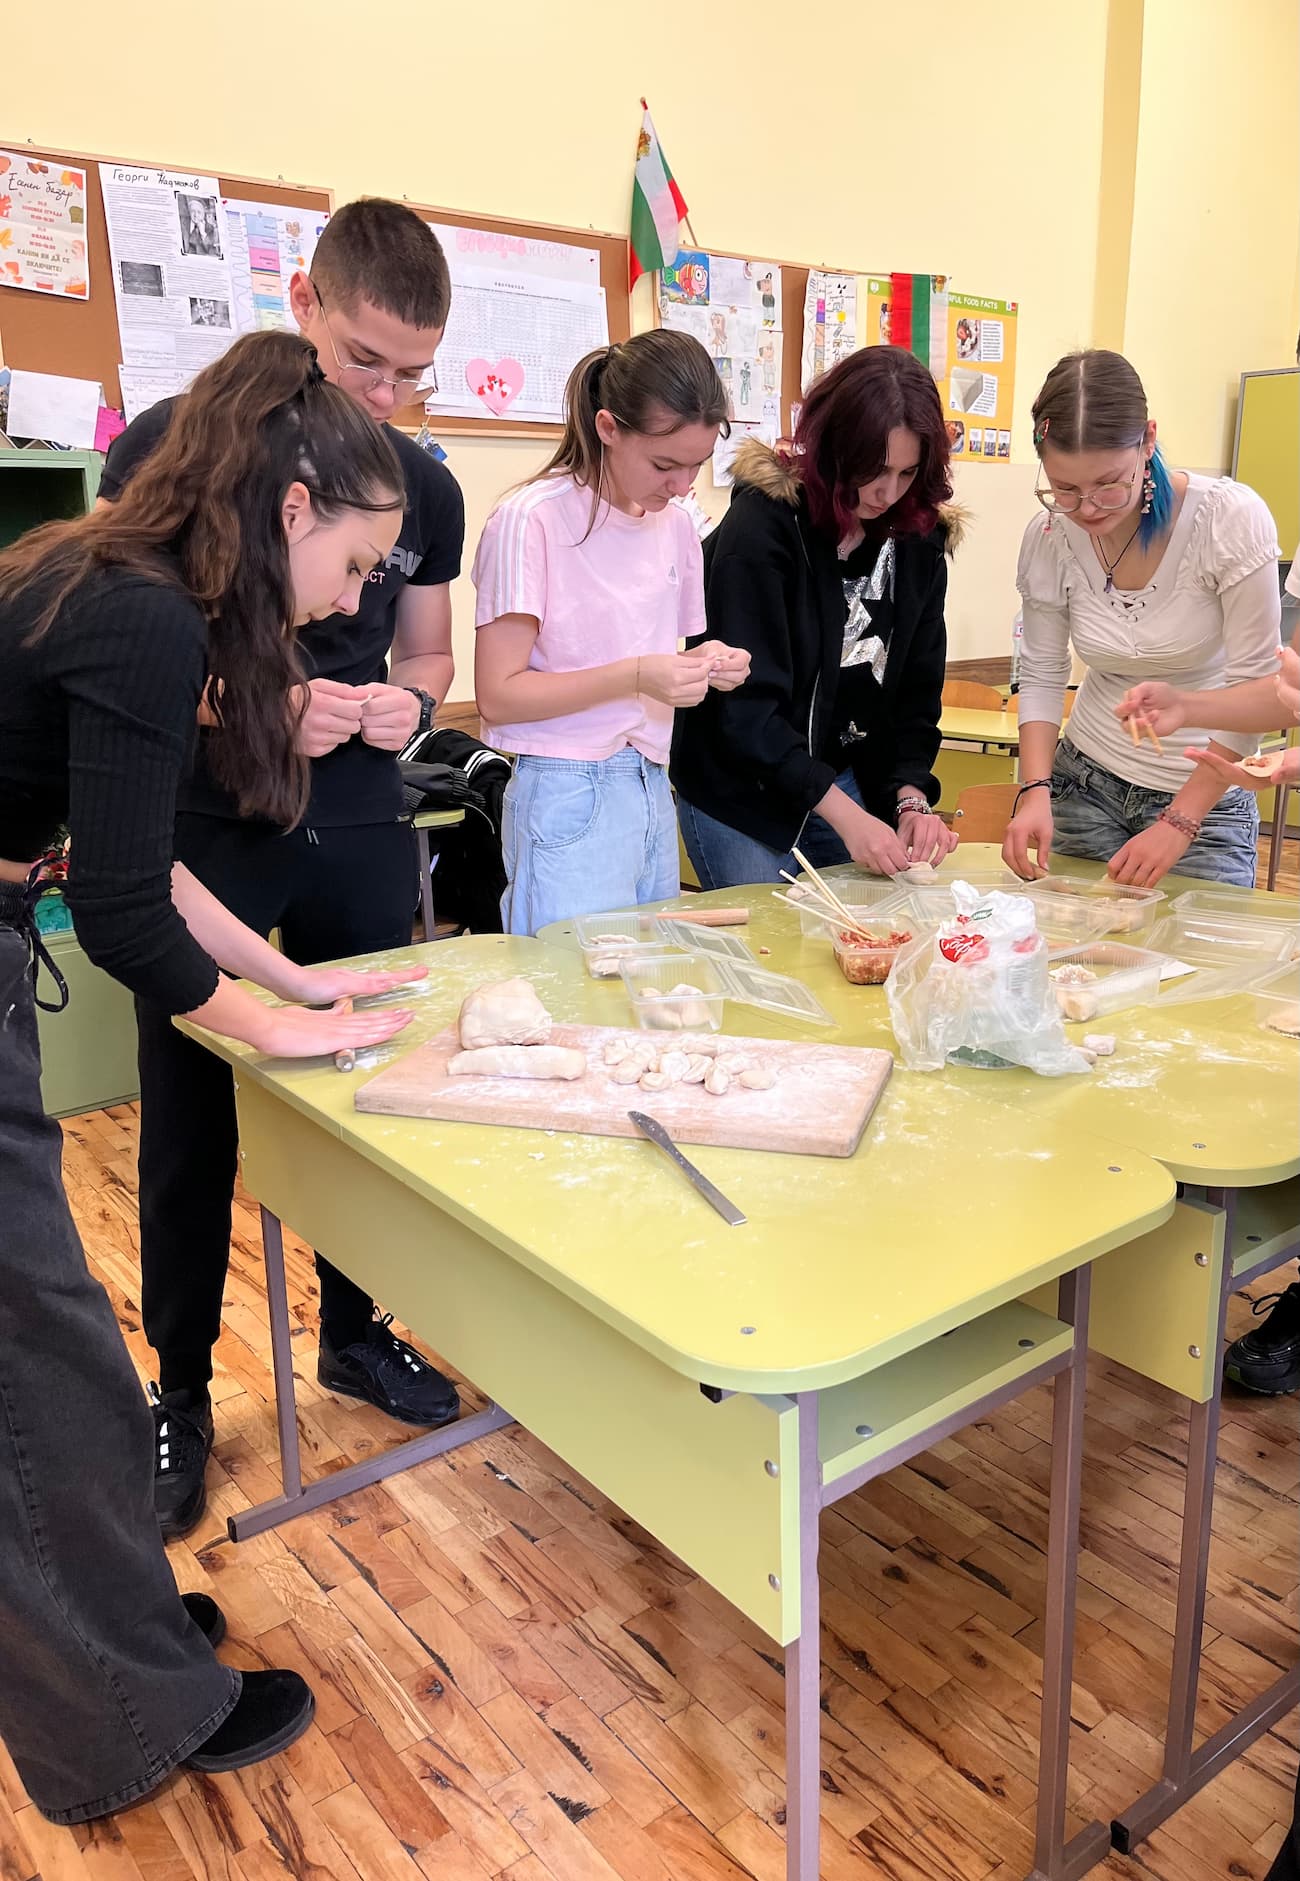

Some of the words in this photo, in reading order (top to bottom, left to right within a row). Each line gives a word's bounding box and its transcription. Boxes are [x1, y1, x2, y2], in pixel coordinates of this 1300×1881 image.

[113, 169, 149, 183] Георги
[963, 296, 980, 307] FOOD
[981, 301, 998, 310] FACTS
